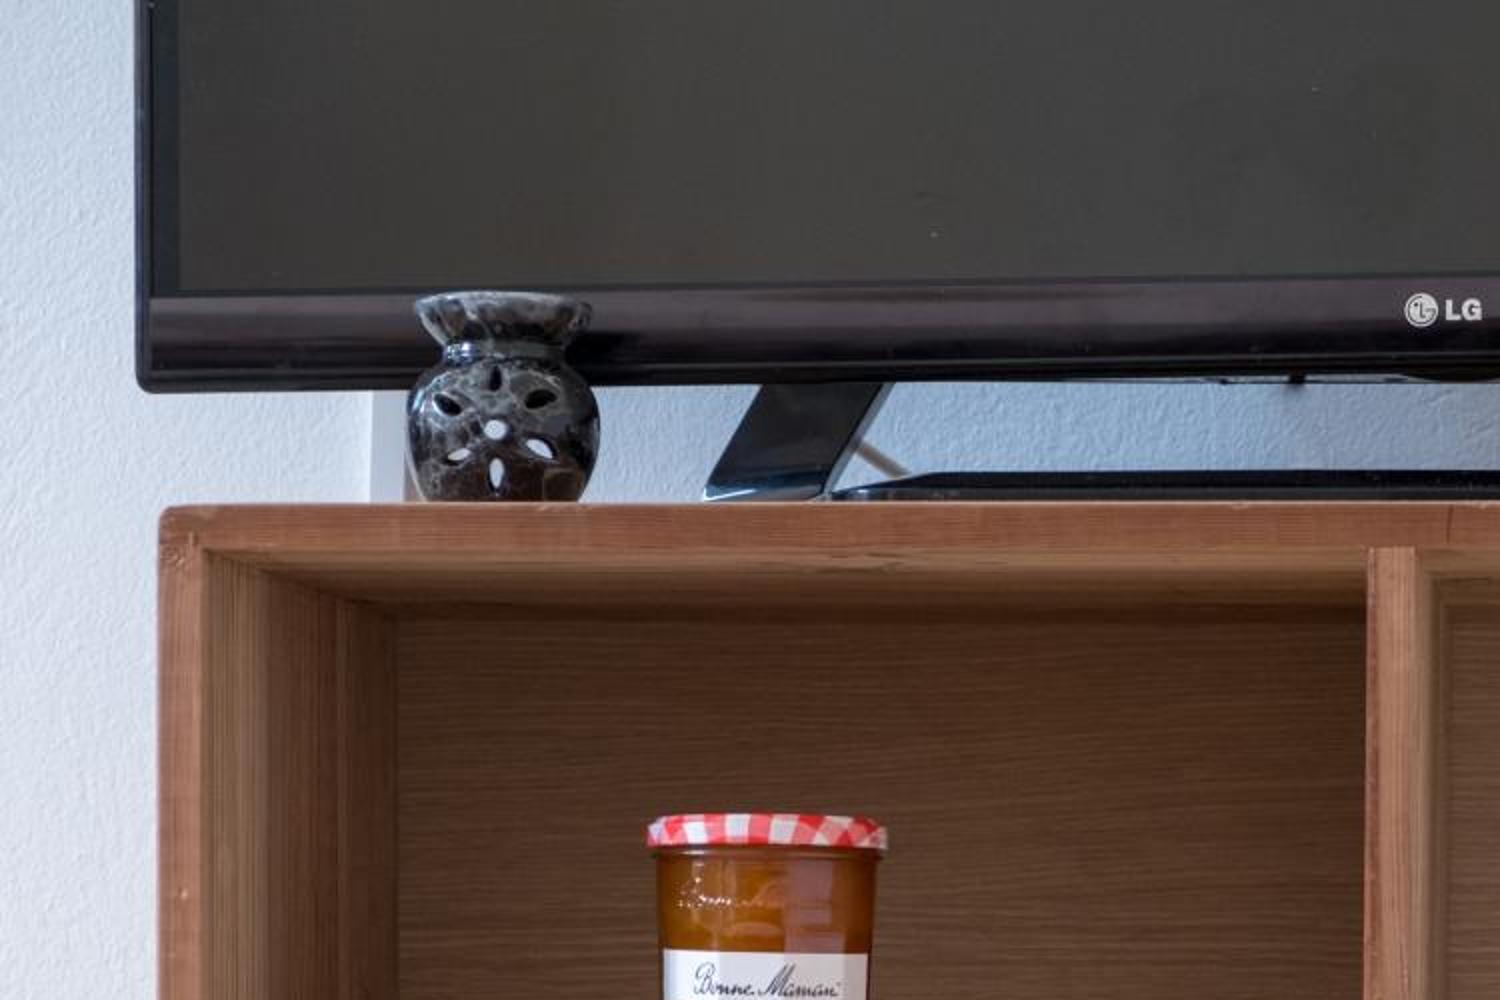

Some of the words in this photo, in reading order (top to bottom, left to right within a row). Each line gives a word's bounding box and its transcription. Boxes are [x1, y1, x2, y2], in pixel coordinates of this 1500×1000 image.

[1445, 298, 1483, 321] LG
[693, 961, 755, 997] Bonne
[757, 962, 839, 998] Maman
